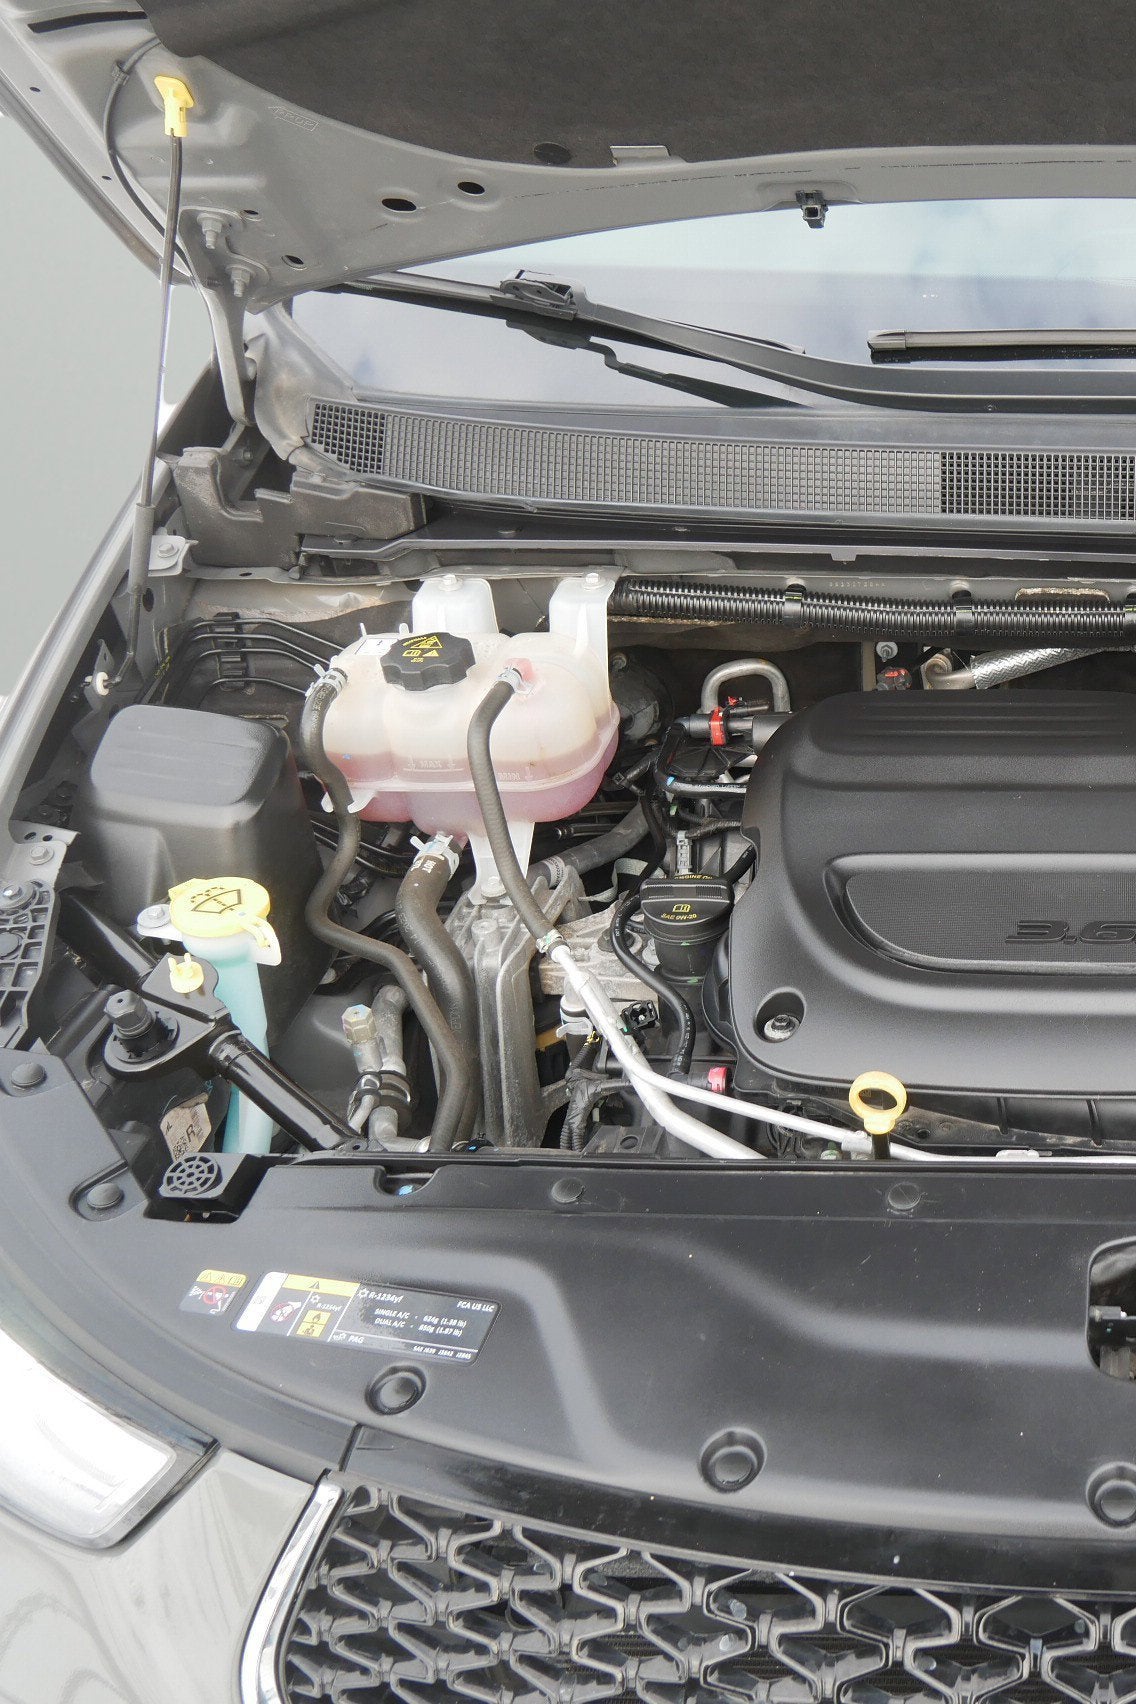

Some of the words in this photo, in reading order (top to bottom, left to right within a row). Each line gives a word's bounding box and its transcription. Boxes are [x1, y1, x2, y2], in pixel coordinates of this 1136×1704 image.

[368, 1290, 404, 1304] R-1234yf
[456, 1300, 471, 1310] FCA
[471, 1302, 482, 1310] US
[483, 1303, 495, 1313] LLC
[347, 1334, 365, 1344] PAG
